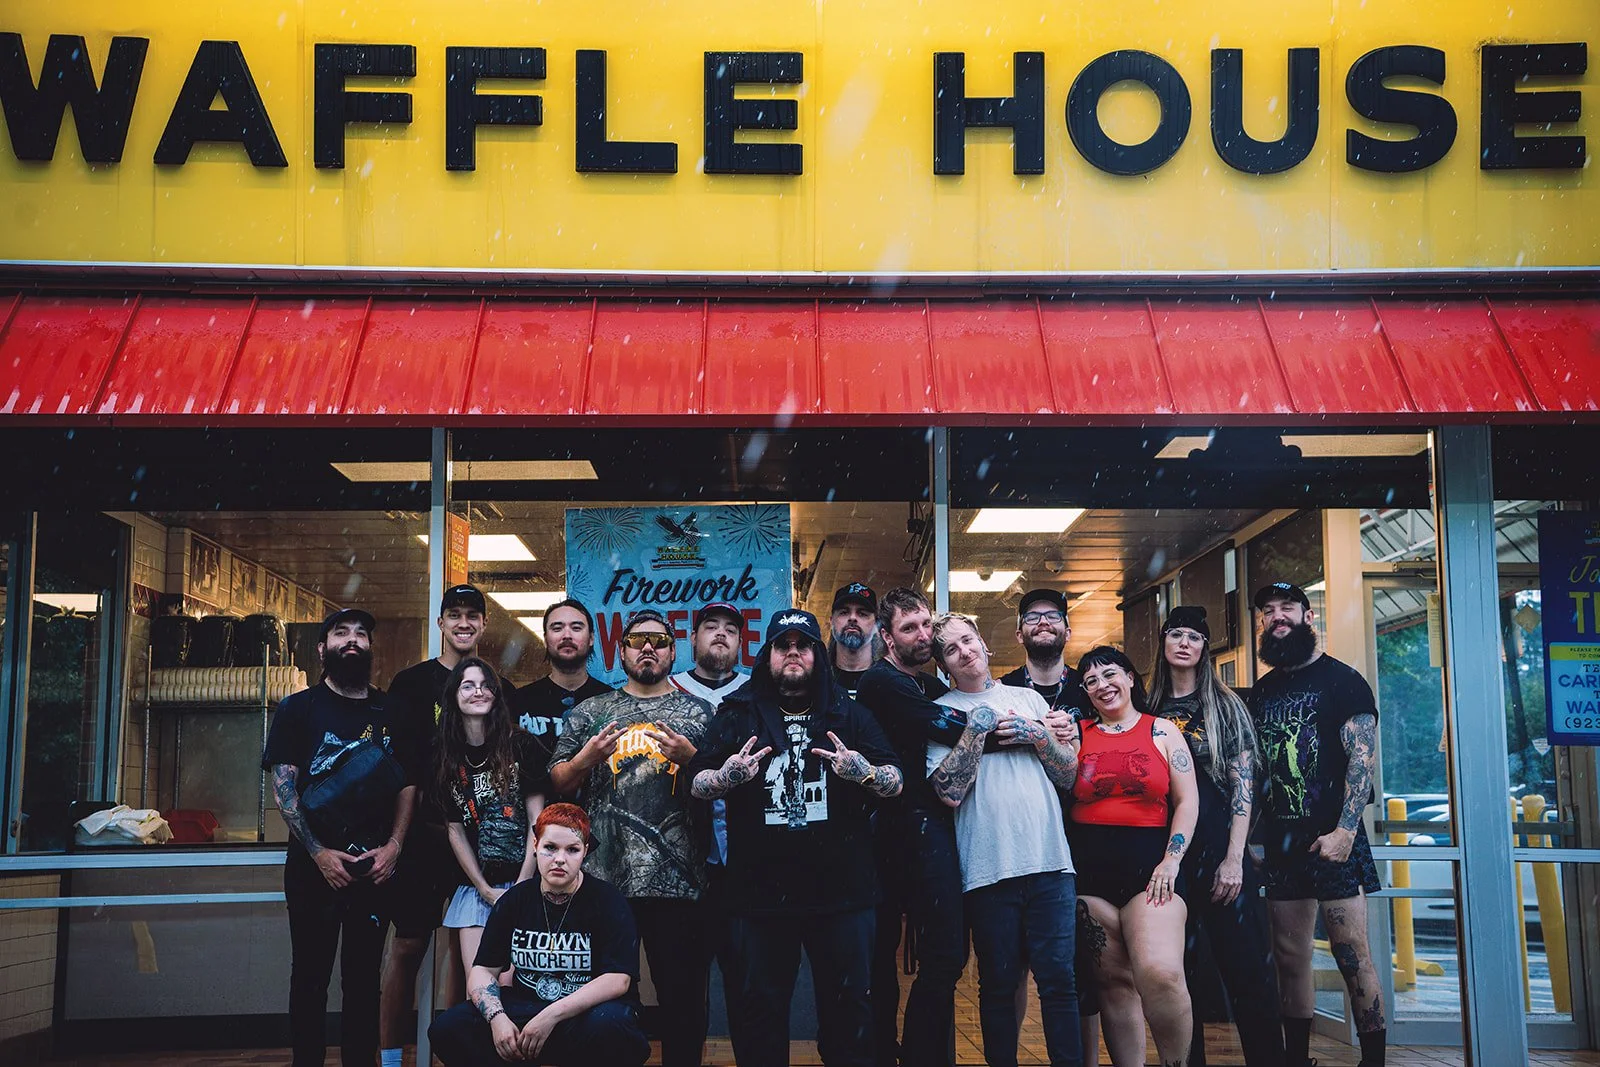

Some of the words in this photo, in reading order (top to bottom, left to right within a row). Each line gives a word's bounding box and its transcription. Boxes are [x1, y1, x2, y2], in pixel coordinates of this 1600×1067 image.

[0, 32, 804, 176] WAFFLE
[932, 42, 1588, 176] HOUSE
[602, 563, 759, 606] Firework
[783, 714, 807, 723] SPIRIT
[511, 929, 592, 951] E-TOWN
[511, 949, 590, 969] CONCRETE
